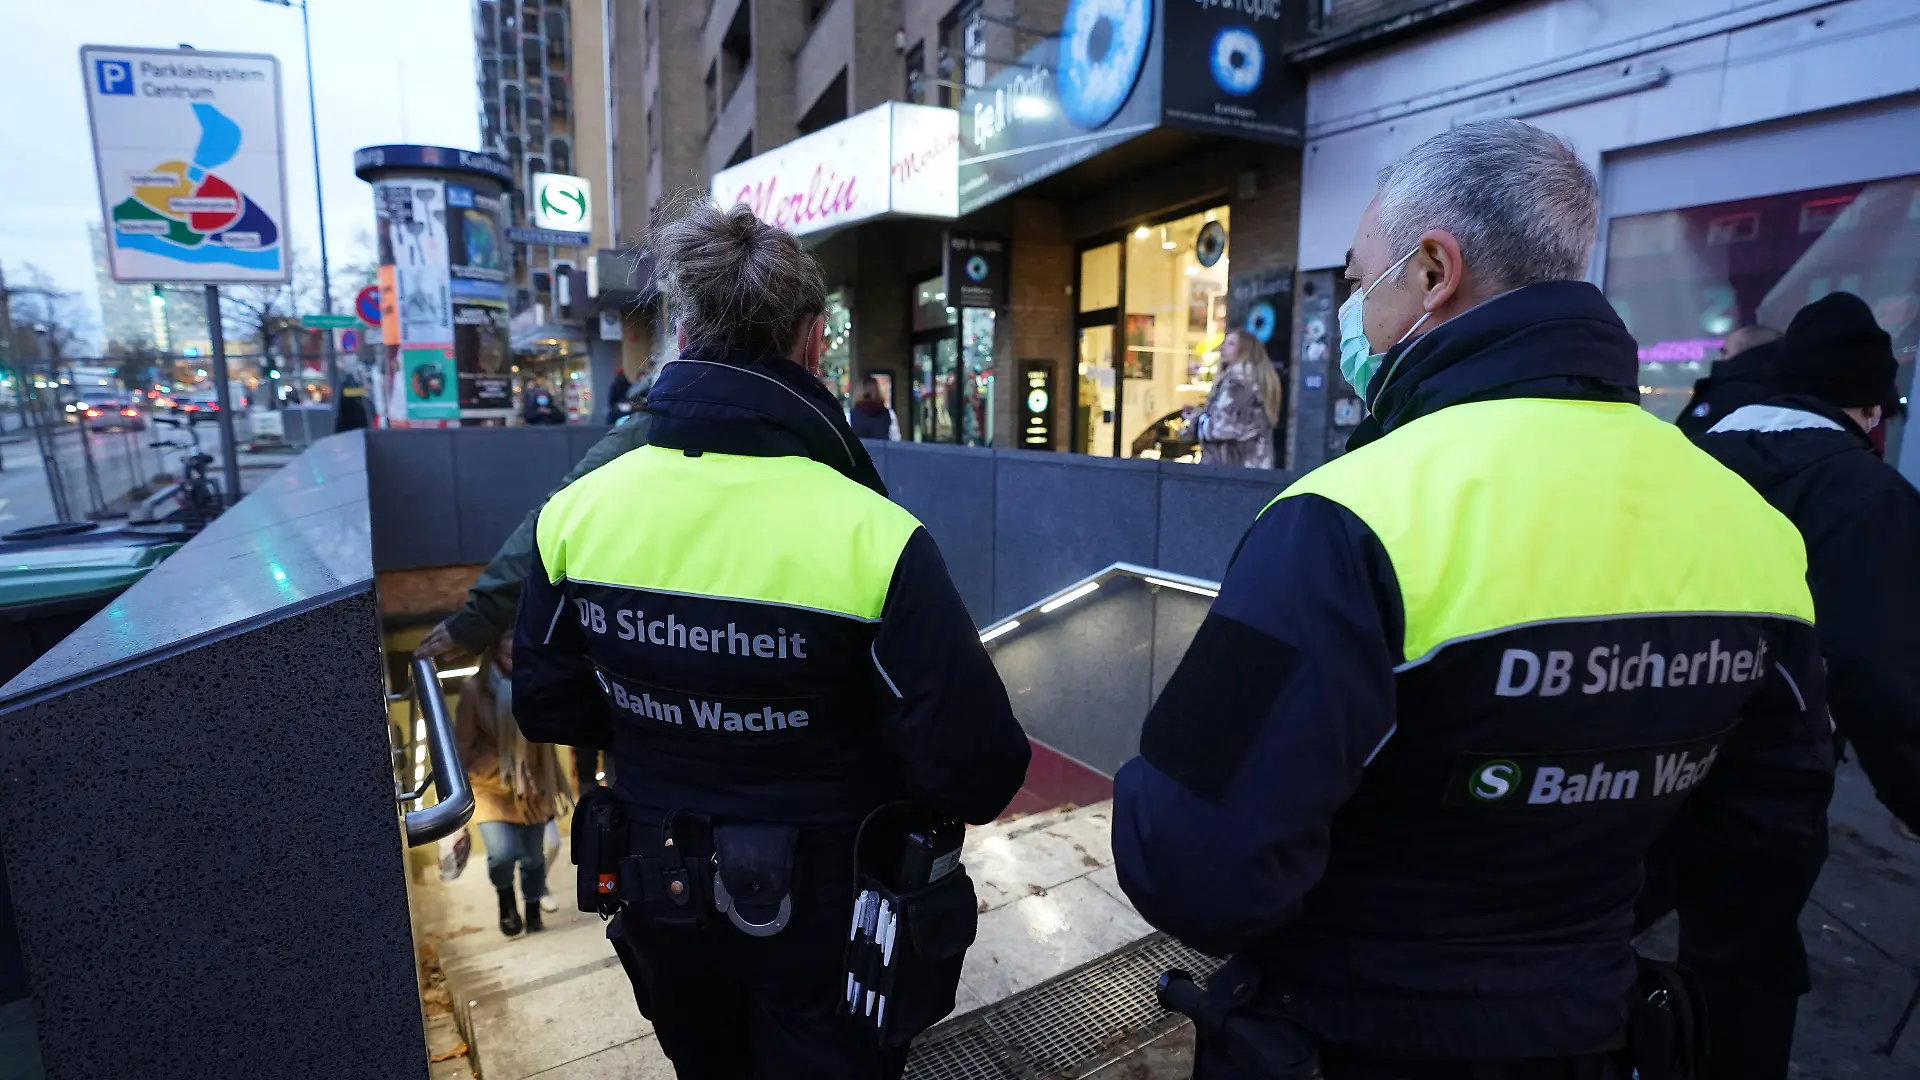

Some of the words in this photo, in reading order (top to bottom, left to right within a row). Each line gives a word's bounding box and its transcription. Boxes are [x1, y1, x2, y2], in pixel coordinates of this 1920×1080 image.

[102, 63, 126, 92] P
[142, 82, 215, 98] Centrum
[540, 181, 587, 225] S
[735, 163, 858, 230] Merlin
[616, 607, 807, 659] Sicherheit
[1494, 648, 1575, 697] DB
[1582, 636, 1768, 694] Sicherheit
[612, 681, 683, 725] Bahn
[688, 698, 809, 732] Wache
[1528, 762, 1640, 804] Bahn
